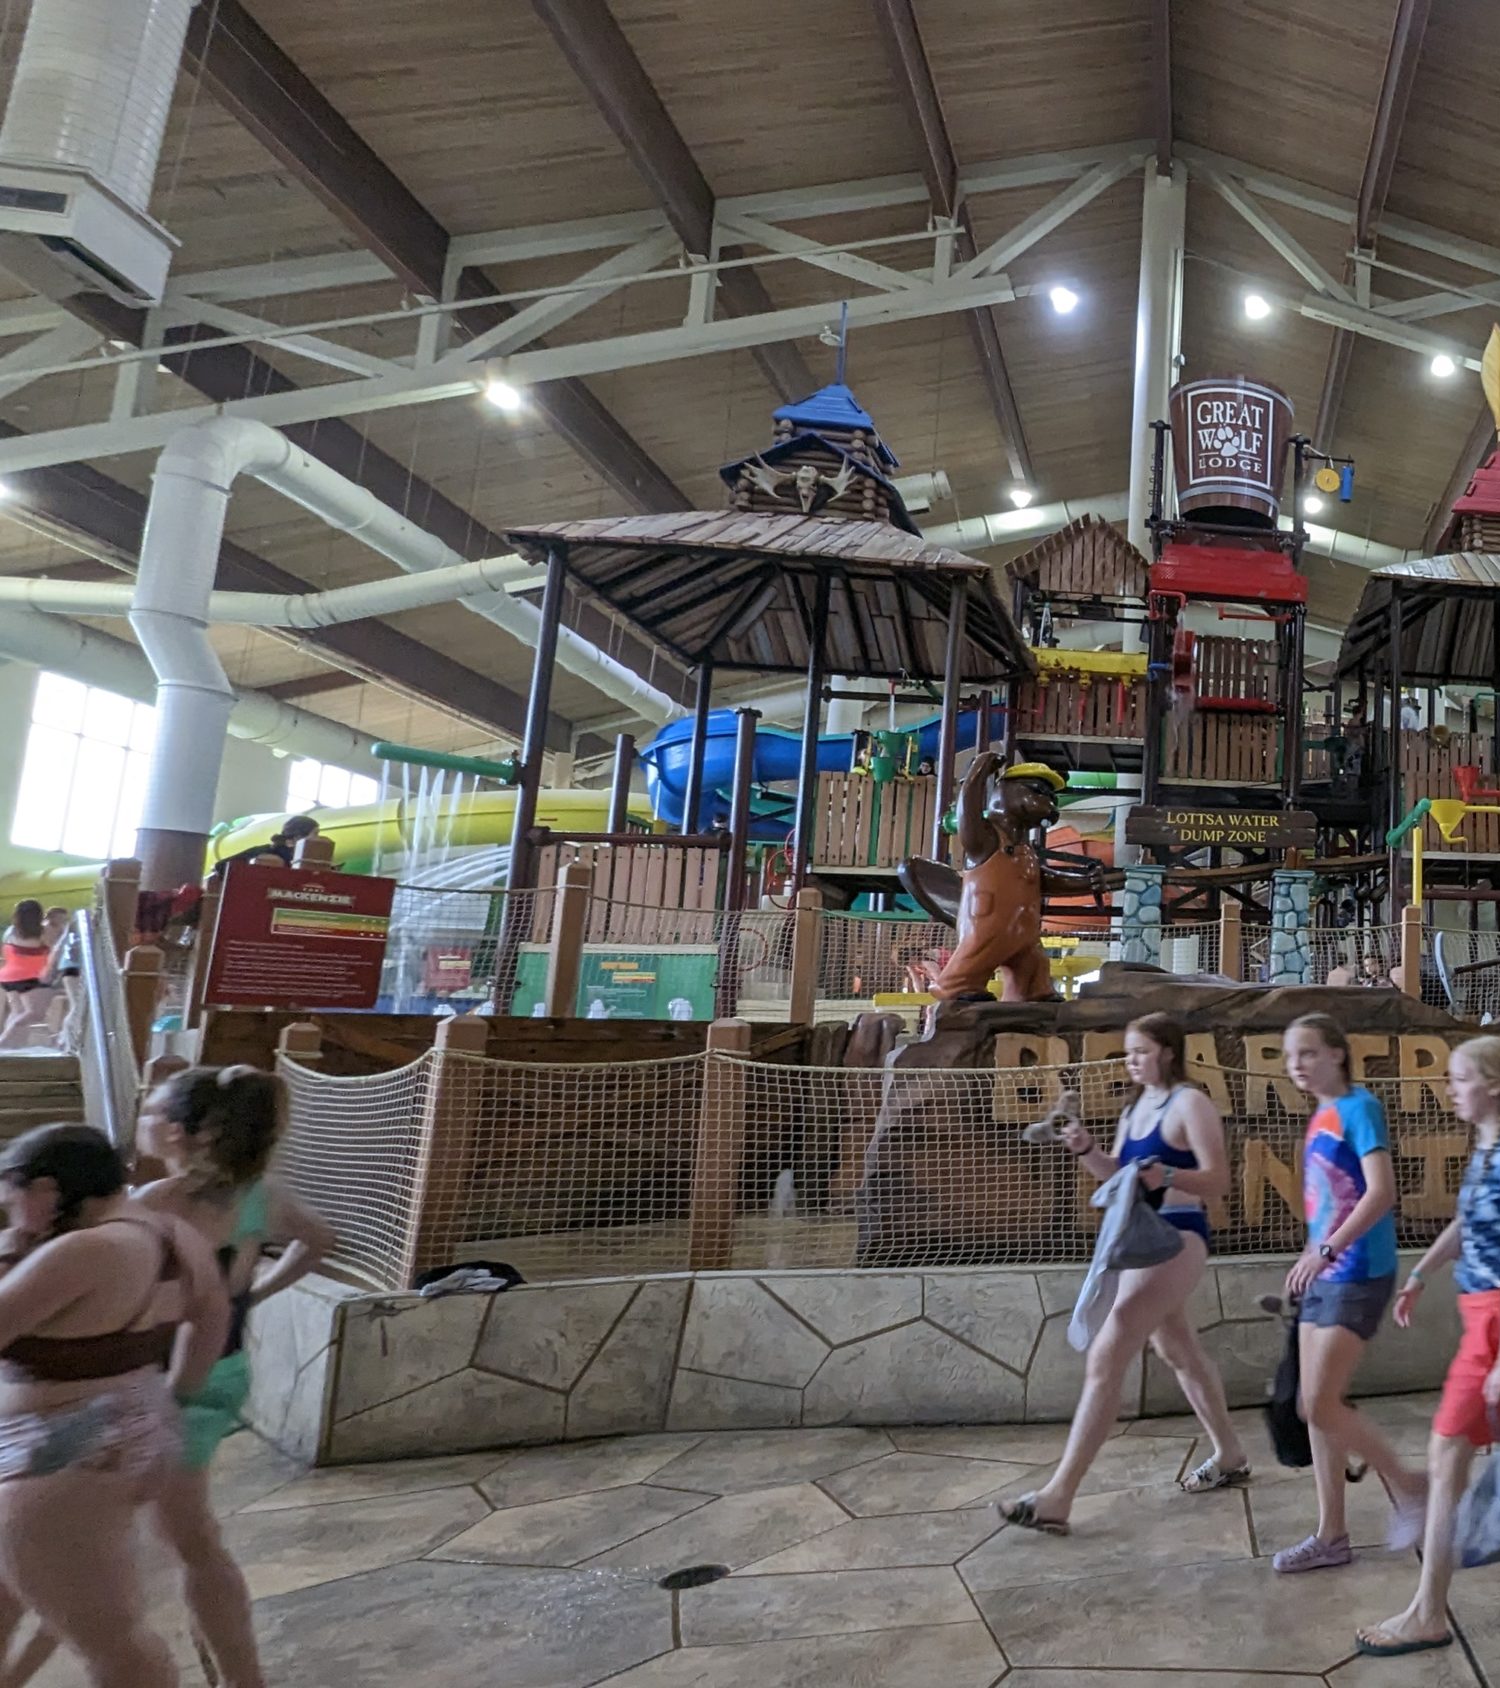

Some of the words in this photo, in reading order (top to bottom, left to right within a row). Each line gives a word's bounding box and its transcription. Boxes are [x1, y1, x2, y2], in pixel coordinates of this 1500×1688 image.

[1197, 401, 1264, 429] GREAT
[1198, 428, 1263, 457] WLF
[1199, 457, 1262, 474] LODGE
[1166, 811, 1225, 826] LOTTSA
[1228, 814, 1280, 828] WATER
[1180, 829, 1224, 843] DUMP
[1227, 831, 1266, 843] ZONE
